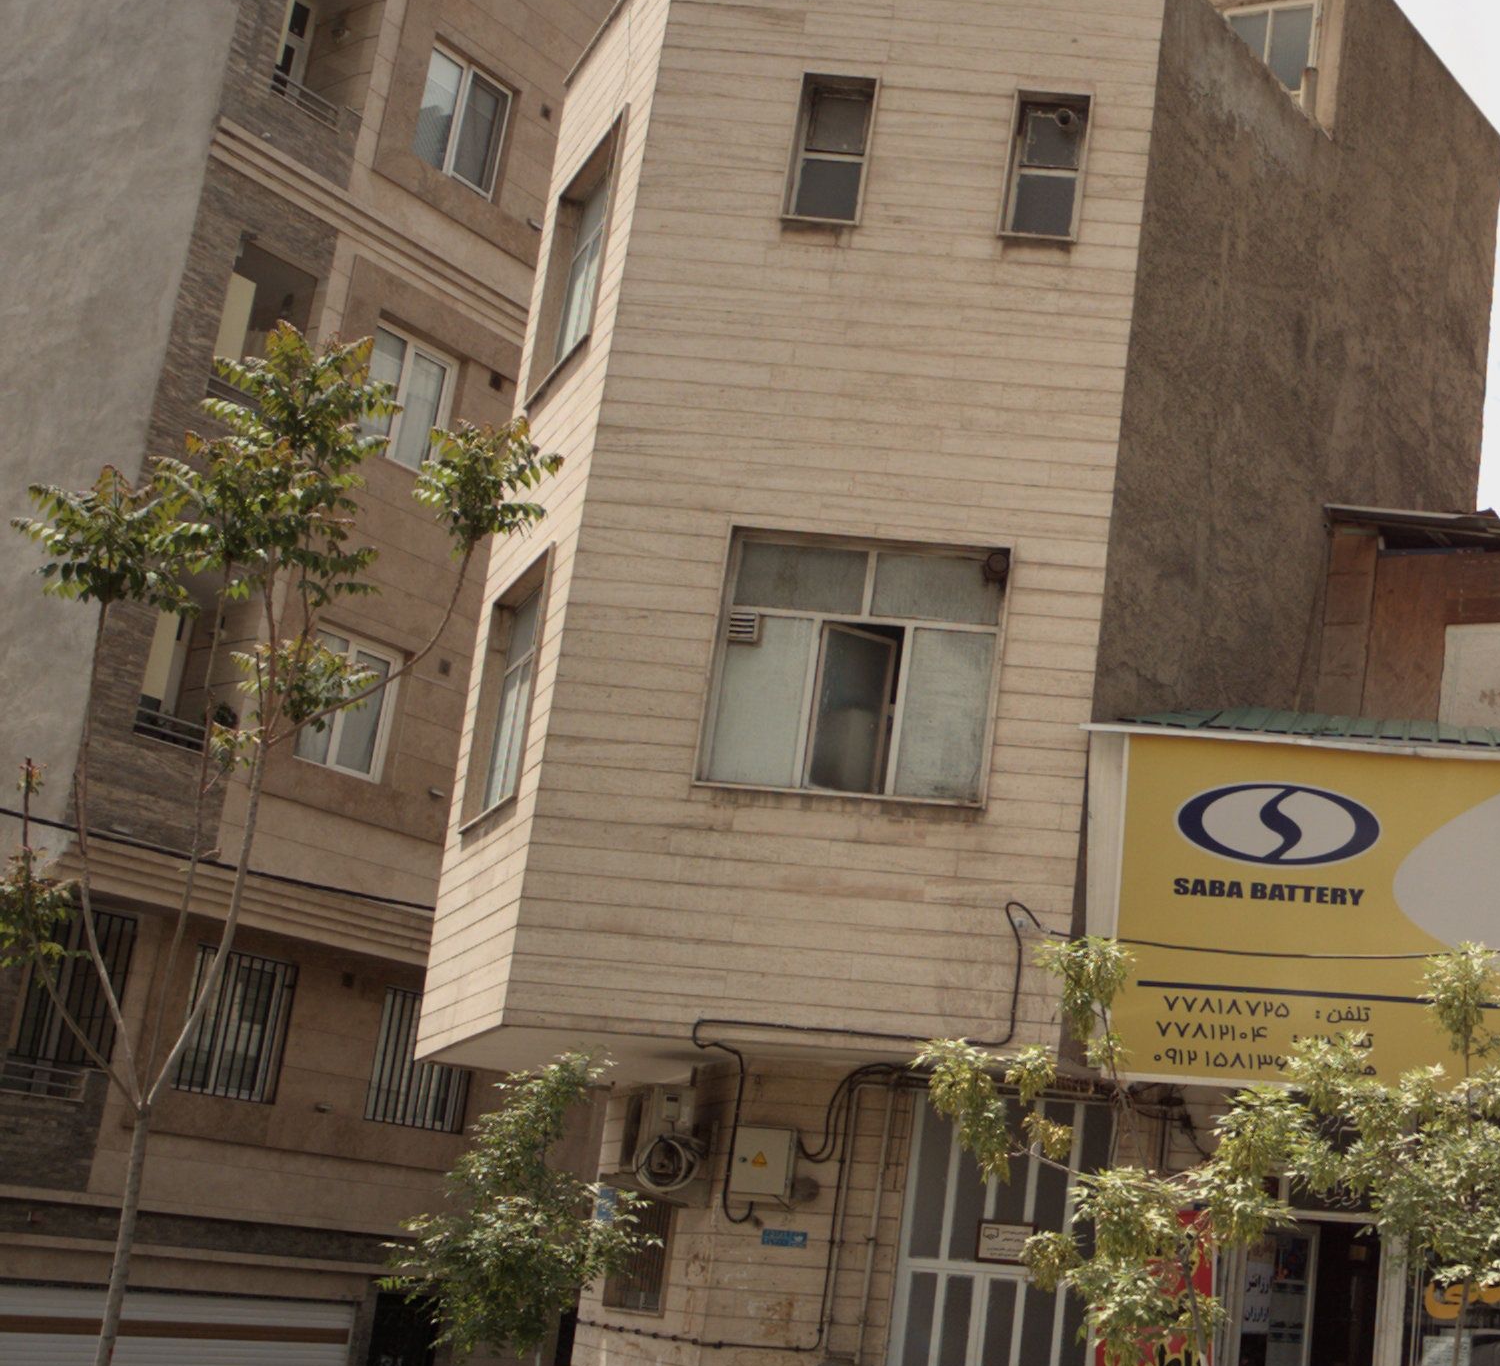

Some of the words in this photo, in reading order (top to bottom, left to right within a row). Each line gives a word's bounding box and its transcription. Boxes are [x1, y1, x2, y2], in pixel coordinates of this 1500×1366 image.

[1173, 877, 1243, 898] SABA
[1250, 882, 1365, 906] BATTERY
[1163, 995, 1290, 1018] ۷۷۸۱۸۷۲۵
[1326, 1006, 1371, 1023] تلفن
[1155, 1021, 1268, 1042] ۷۷۸۱۲۱۰۴
